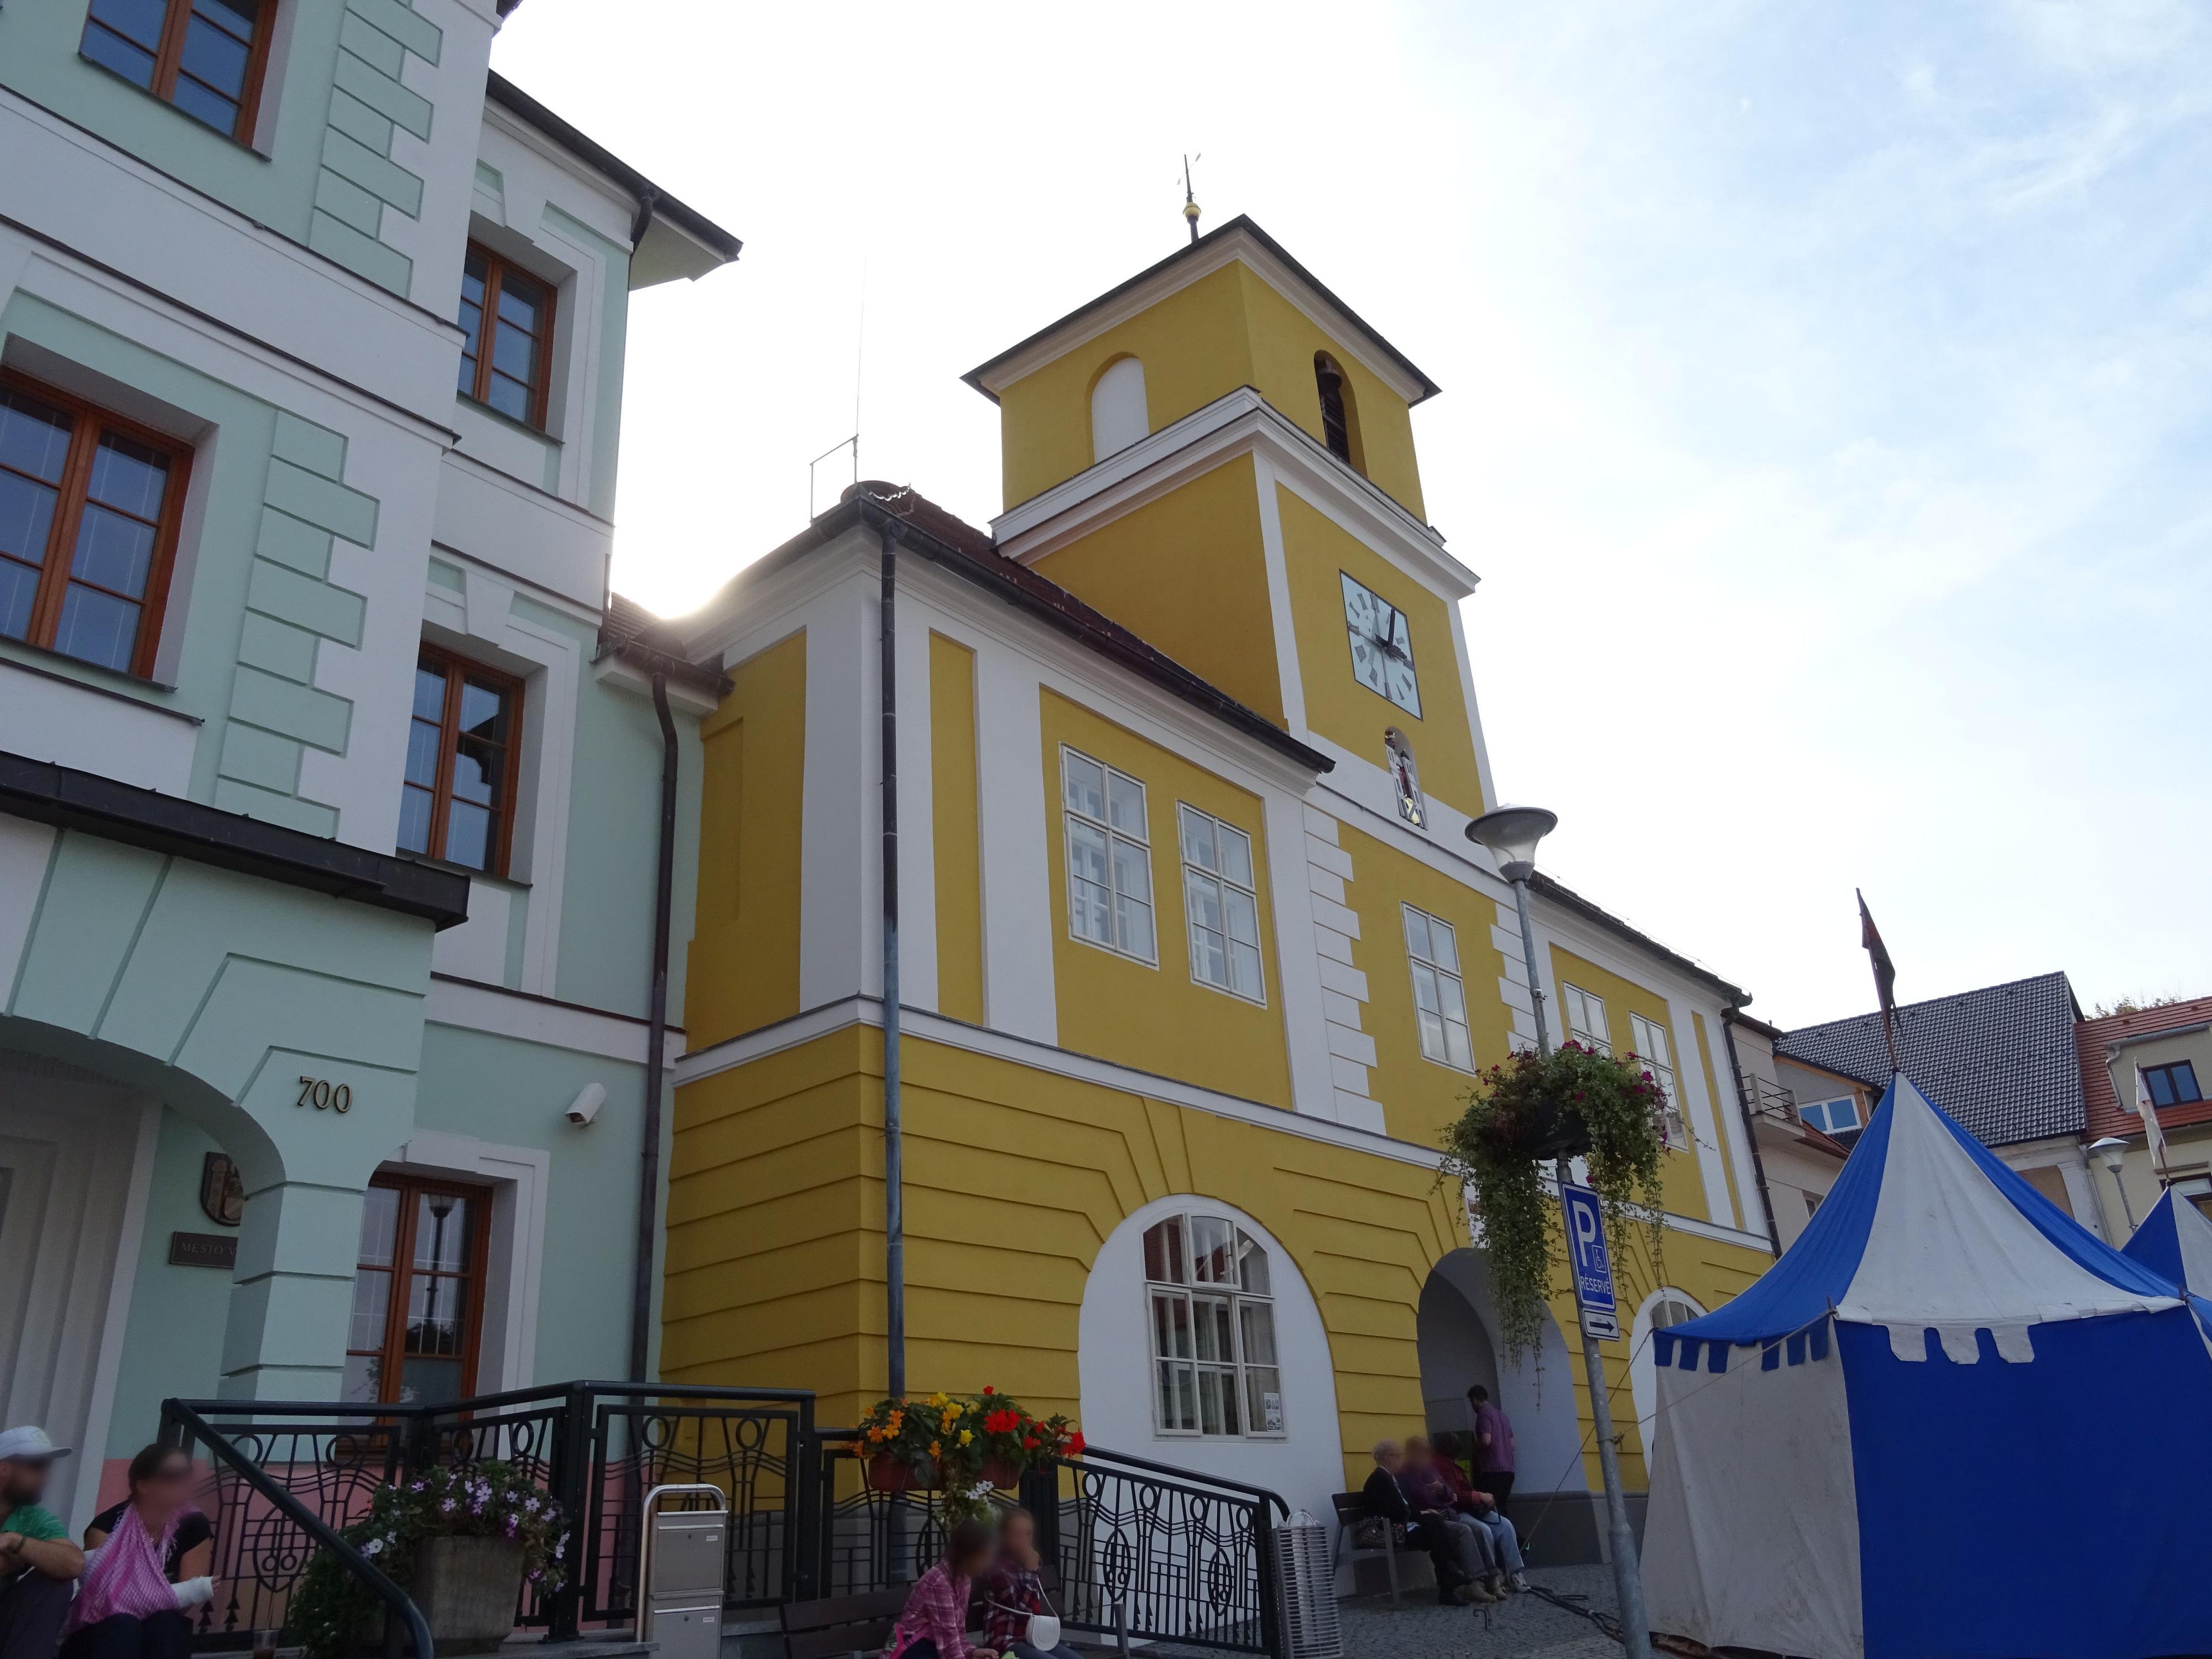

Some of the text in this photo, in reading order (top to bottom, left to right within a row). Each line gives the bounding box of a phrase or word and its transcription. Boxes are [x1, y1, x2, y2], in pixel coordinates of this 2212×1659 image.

[297, 1076, 353, 1113] 700
[1572, 1200, 1596, 1267] P
[1580, 1273, 1611, 1295] RÉSERVÉ
